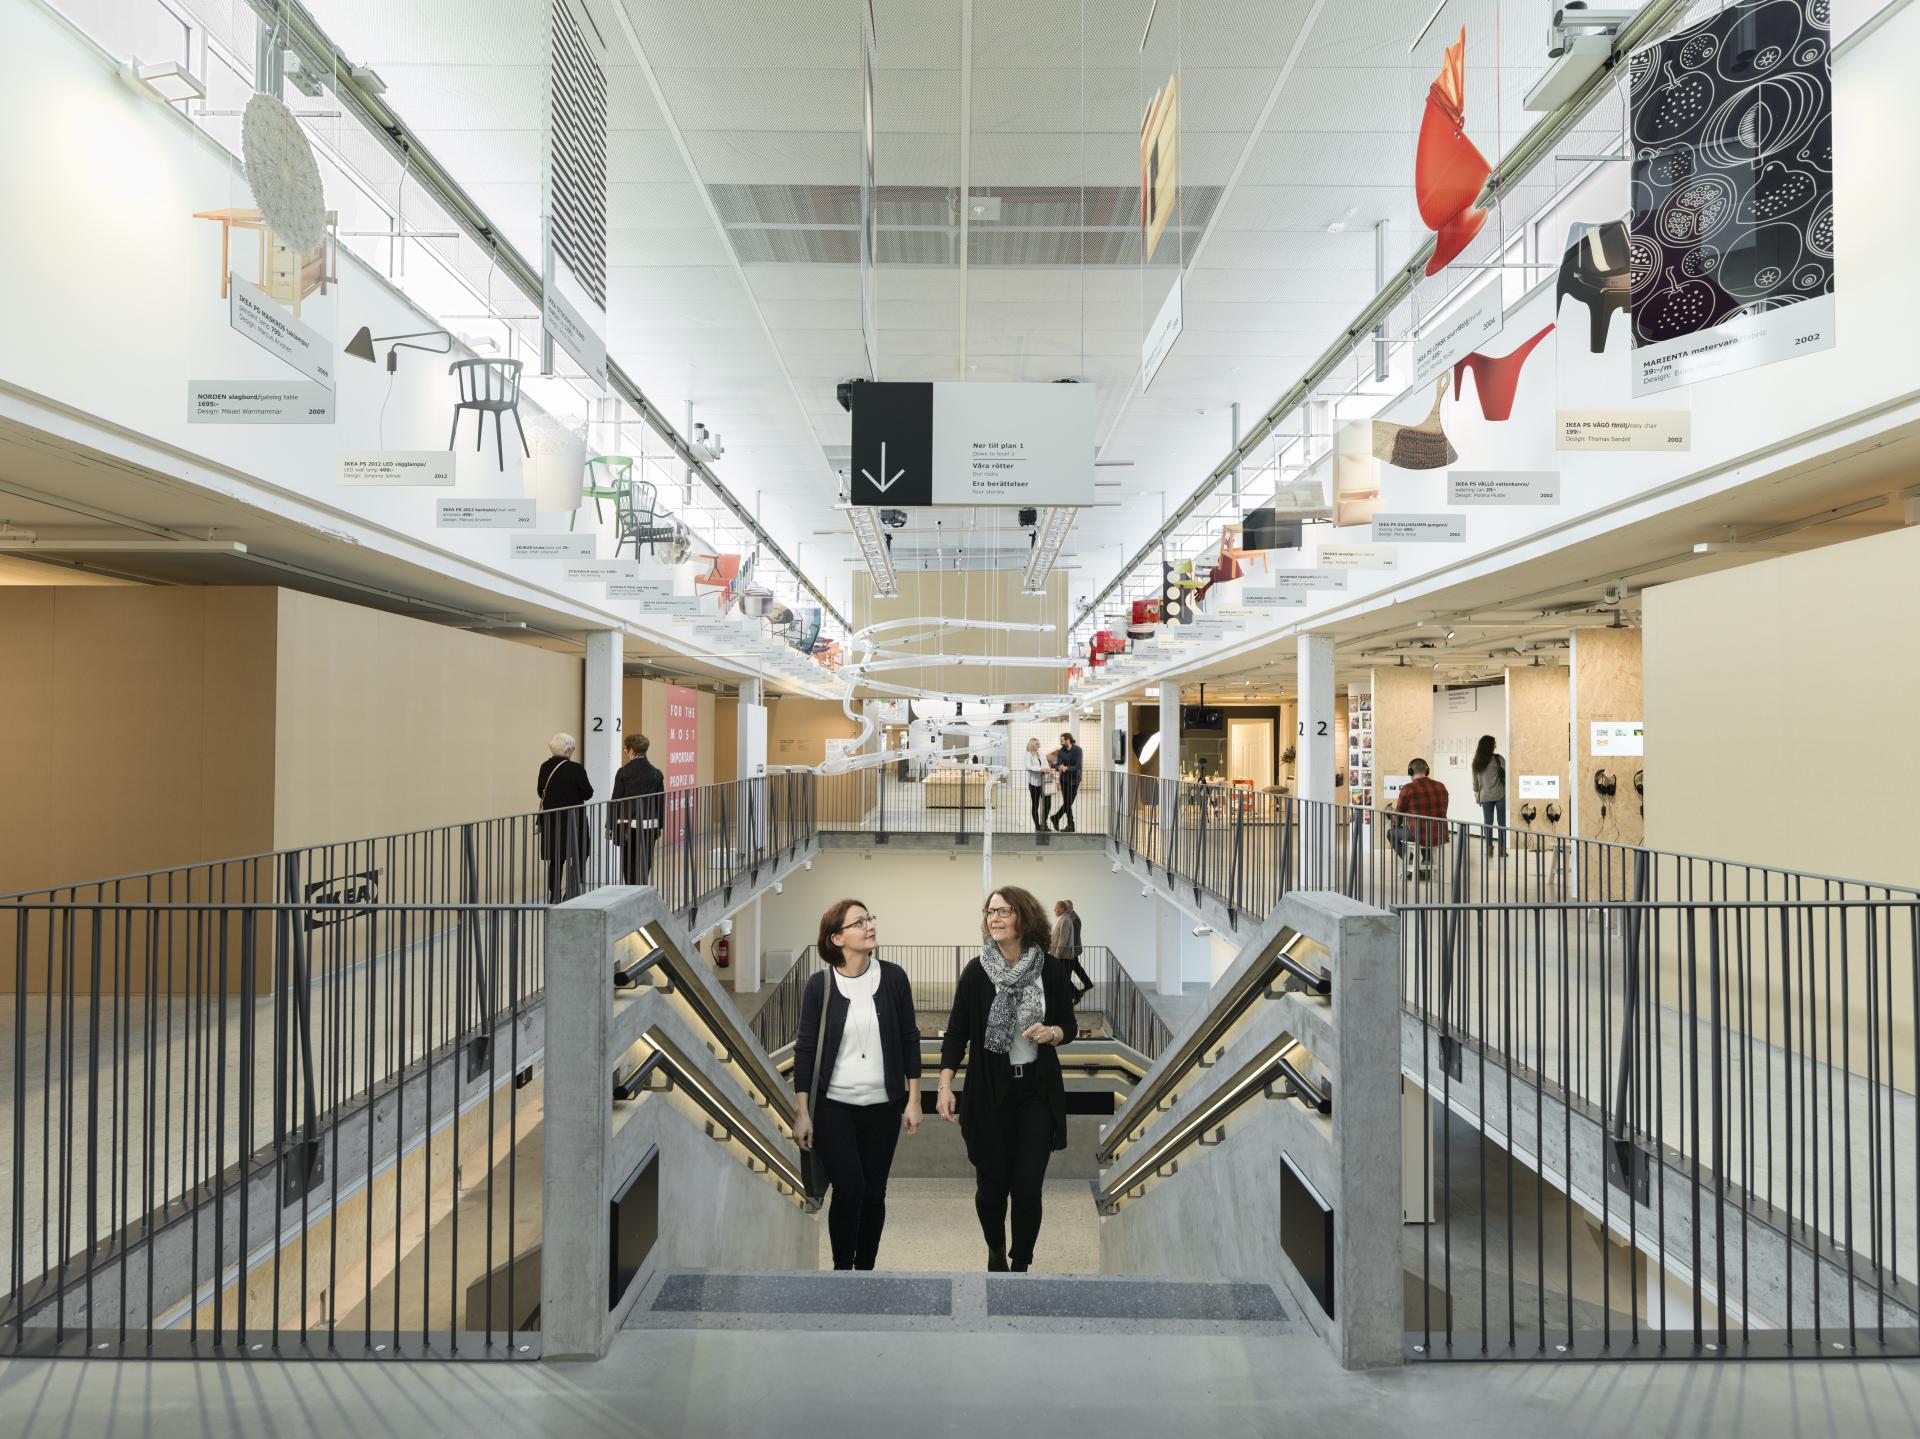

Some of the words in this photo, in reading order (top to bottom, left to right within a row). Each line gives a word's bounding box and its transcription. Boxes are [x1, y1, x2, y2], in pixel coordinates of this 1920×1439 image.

[239, 294, 253, 309] IKEA
[1483, 317, 1496, 331] 2004
[1795, 333, 1821, 346] 2002
[1643, 351, 1688, 368] MARIENTA
[1643, 364, 1672, 377] 39:-/m
[1643, 372, 1672, 385] Design:
[197, 408, 219, 416] Design:
[1001, 442, 1017, 450] plan
[670, 704, 682, 718] FOR
[685, 706, 695, 718] THE
[593, 717, 604, 732] 2
[616, 718, 622, 732] 2
[1317, 721, 1328, 736] 2
[670, 728, 695, 740] MOST
[670, 751, 695, 763] IMPORTANT
[670, 775, 688, 788] PEOPLE
[688, 774, 695, 785] IN
